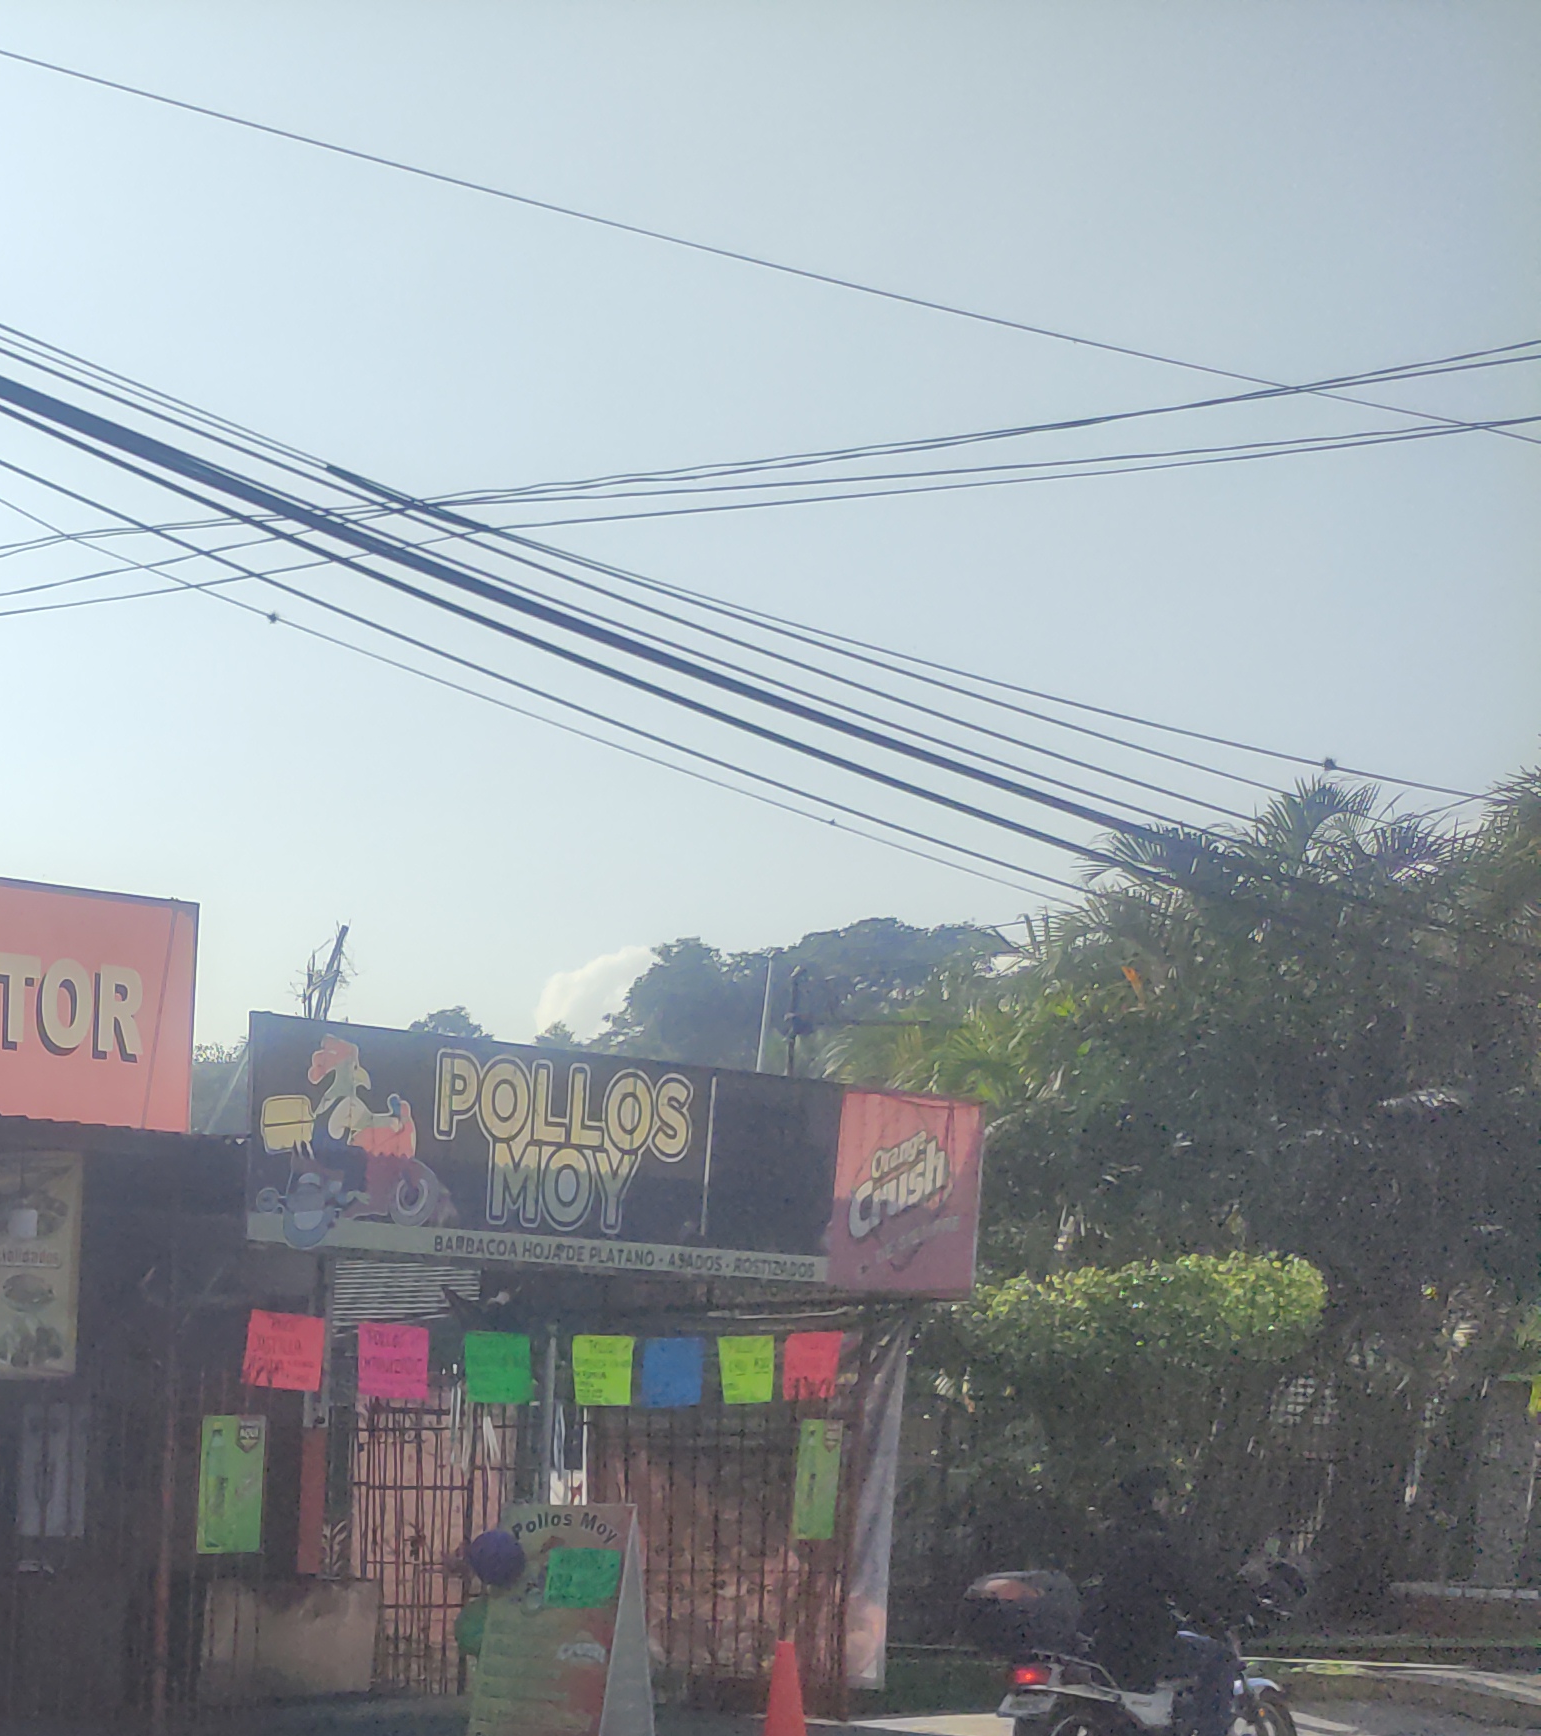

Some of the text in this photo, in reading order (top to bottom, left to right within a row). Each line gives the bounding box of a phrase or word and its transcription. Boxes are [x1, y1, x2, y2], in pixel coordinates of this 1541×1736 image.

[433, 1045, 696, 1163] POLLOS
[487, 1136, 641, 1234] MOY
[848, 1137, 948, 1239] Crush
[871, 1130, 927, 1179] Orange
[433, 1235, 518, 1259] BARBACOA
[522, 1243, 562, 1262] HOJA
[564, 1245, 585, 1263] DE
[588, 1247, 655, 1268] PLATANO
[732, 1259, 817, 1280] ROSTIZADOS
[511, 1511, 619, 1545] Pollos Moy
